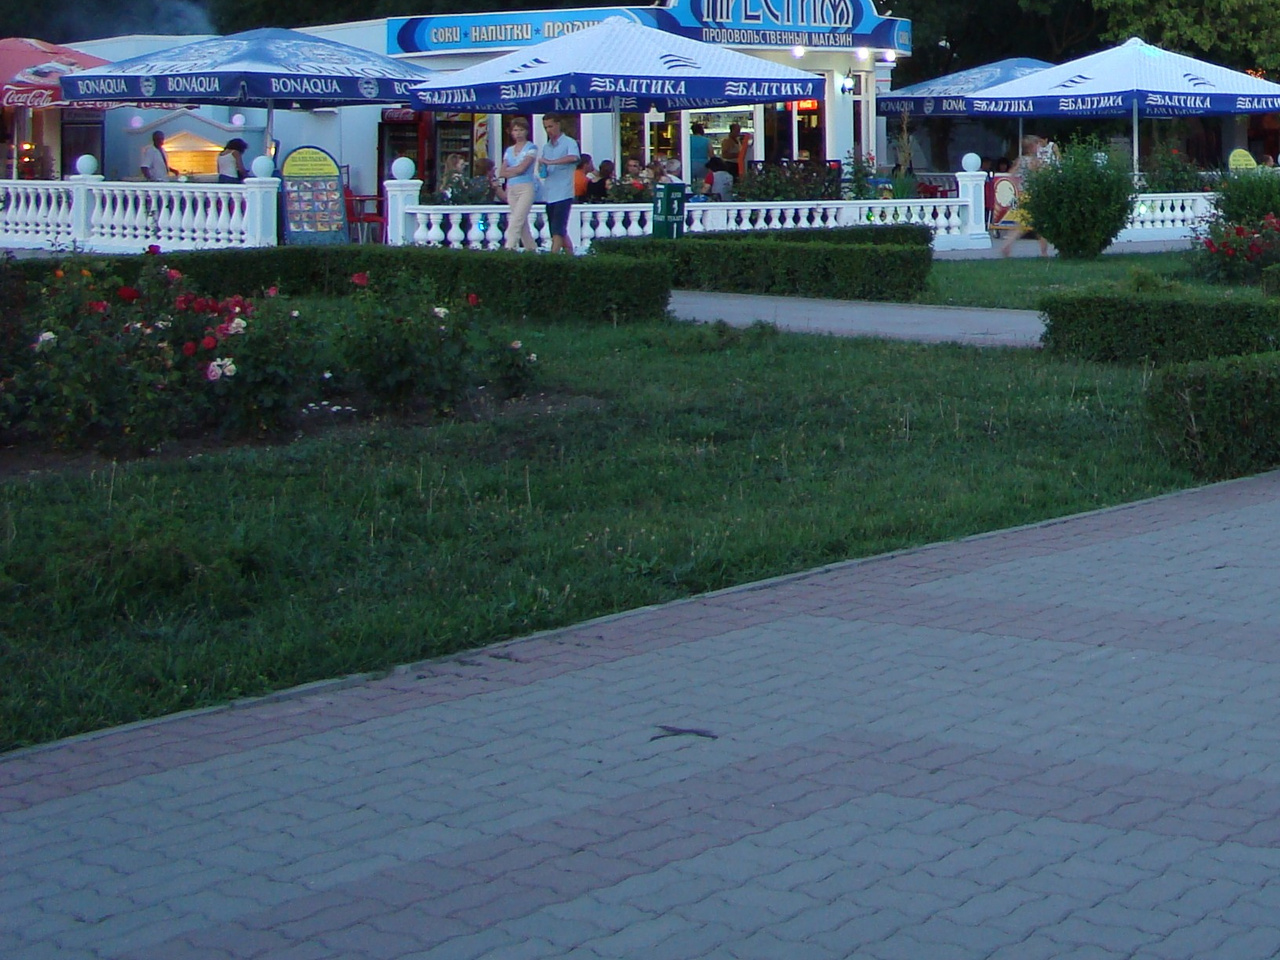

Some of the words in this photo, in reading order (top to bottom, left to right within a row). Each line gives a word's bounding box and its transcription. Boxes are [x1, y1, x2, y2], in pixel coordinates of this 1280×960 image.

[431, 27, 461, 44] СОКИ
[471, 24, 532, 42] НАПИТКИ
[702, 28, 809, 46] ПРОДОВОЛЬСТВЕННЫЙ
[812, 33, 852, 47] МАГАЗИН
[78, 78, 128, 95] BONAQUA
[168, 76, 220, 93] BONAQUA
[271, 77, 341, 94] BONAQUA
[508, 79, 562, 99] БАЛТИКА
[604, 77, 687, 95] БАЛТИКА
[737, 81, 813, 97] БАЛТИКА
[3, 87, 53, 107] Coca-Cola
[425, 88, 477, 104] БАЛТИКА
[1068, 94, 1123, 110] БАЛТИКА
[1157, 94, 1211, 109] БАЛТИКА
[981, 99, 1034, 113] БАЛТИКА
